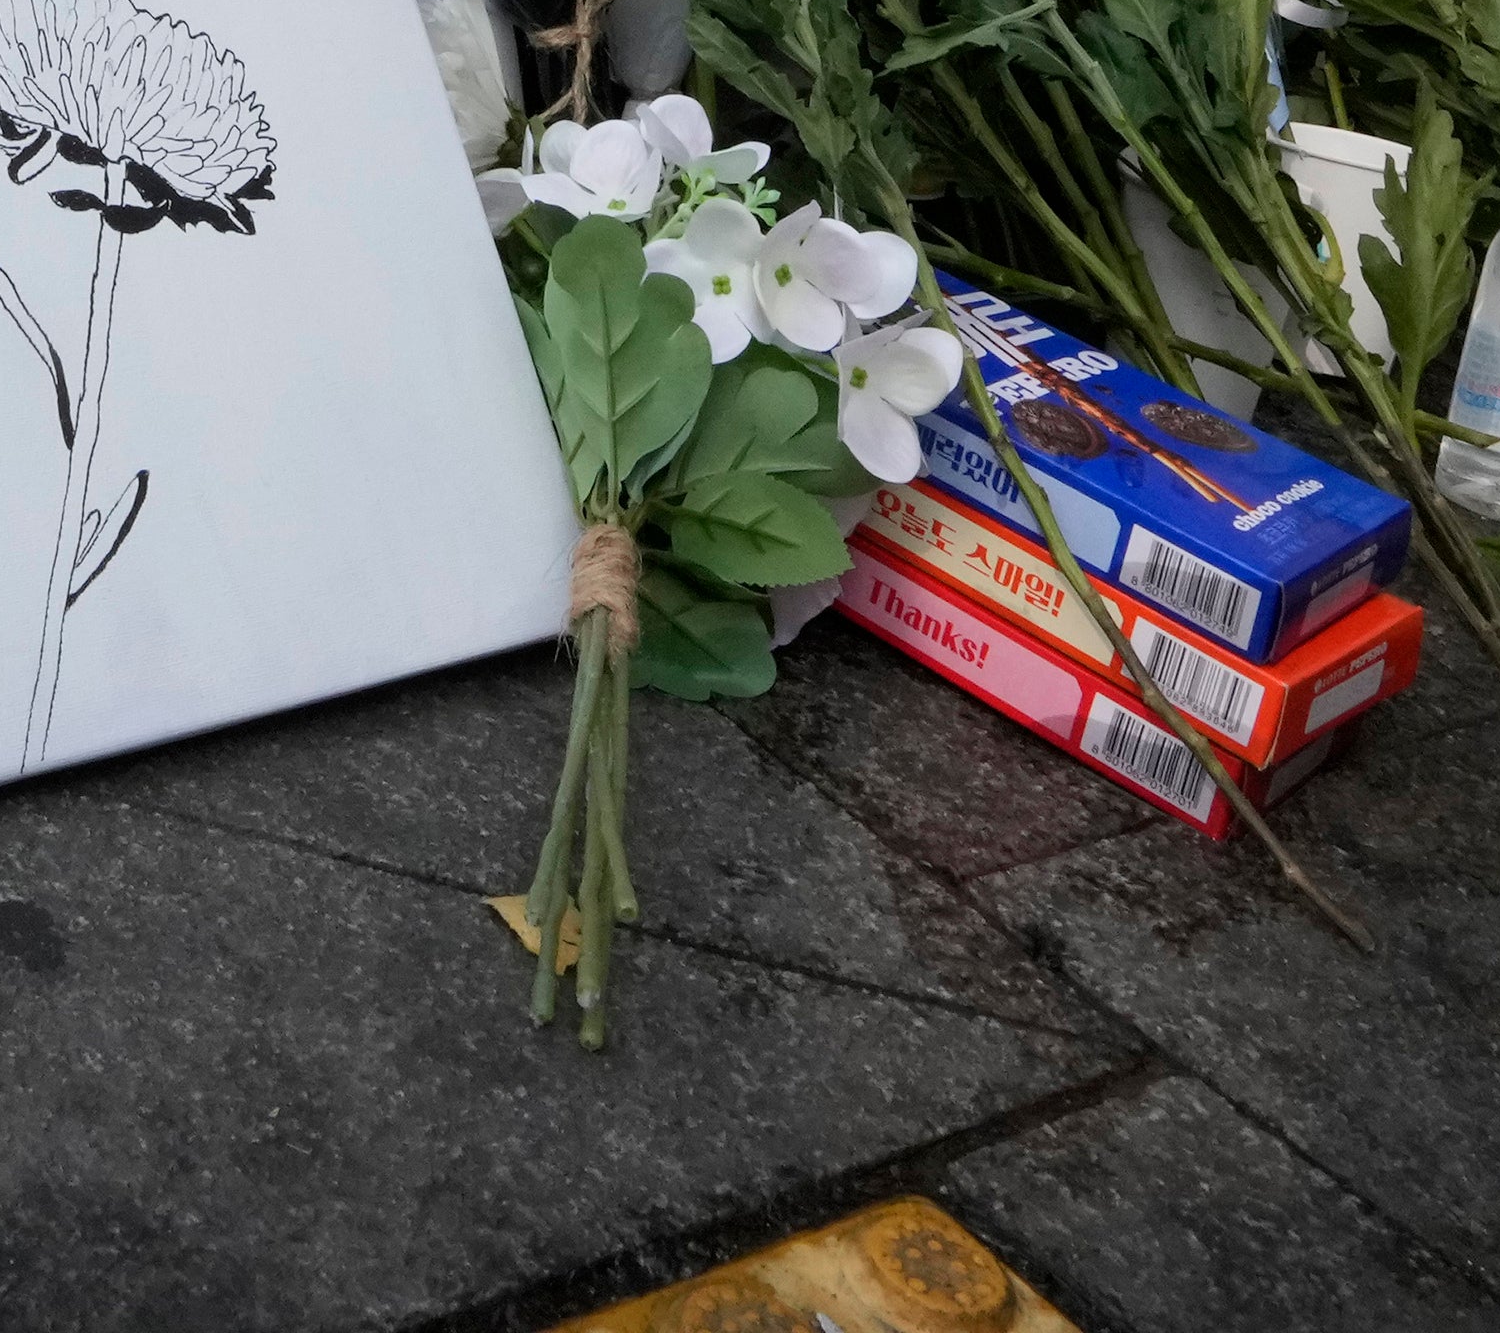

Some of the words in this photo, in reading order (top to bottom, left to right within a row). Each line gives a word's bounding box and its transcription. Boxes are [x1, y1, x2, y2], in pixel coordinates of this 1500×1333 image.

[1232, 501, 1282, 532] choco
[1276, 478, 1325, 510] cookie
[871, 489, 957, 557] 오늘도
[962, 543, 1065, 618] 스마일!
[867, 578, 990, 670] Thanks!
